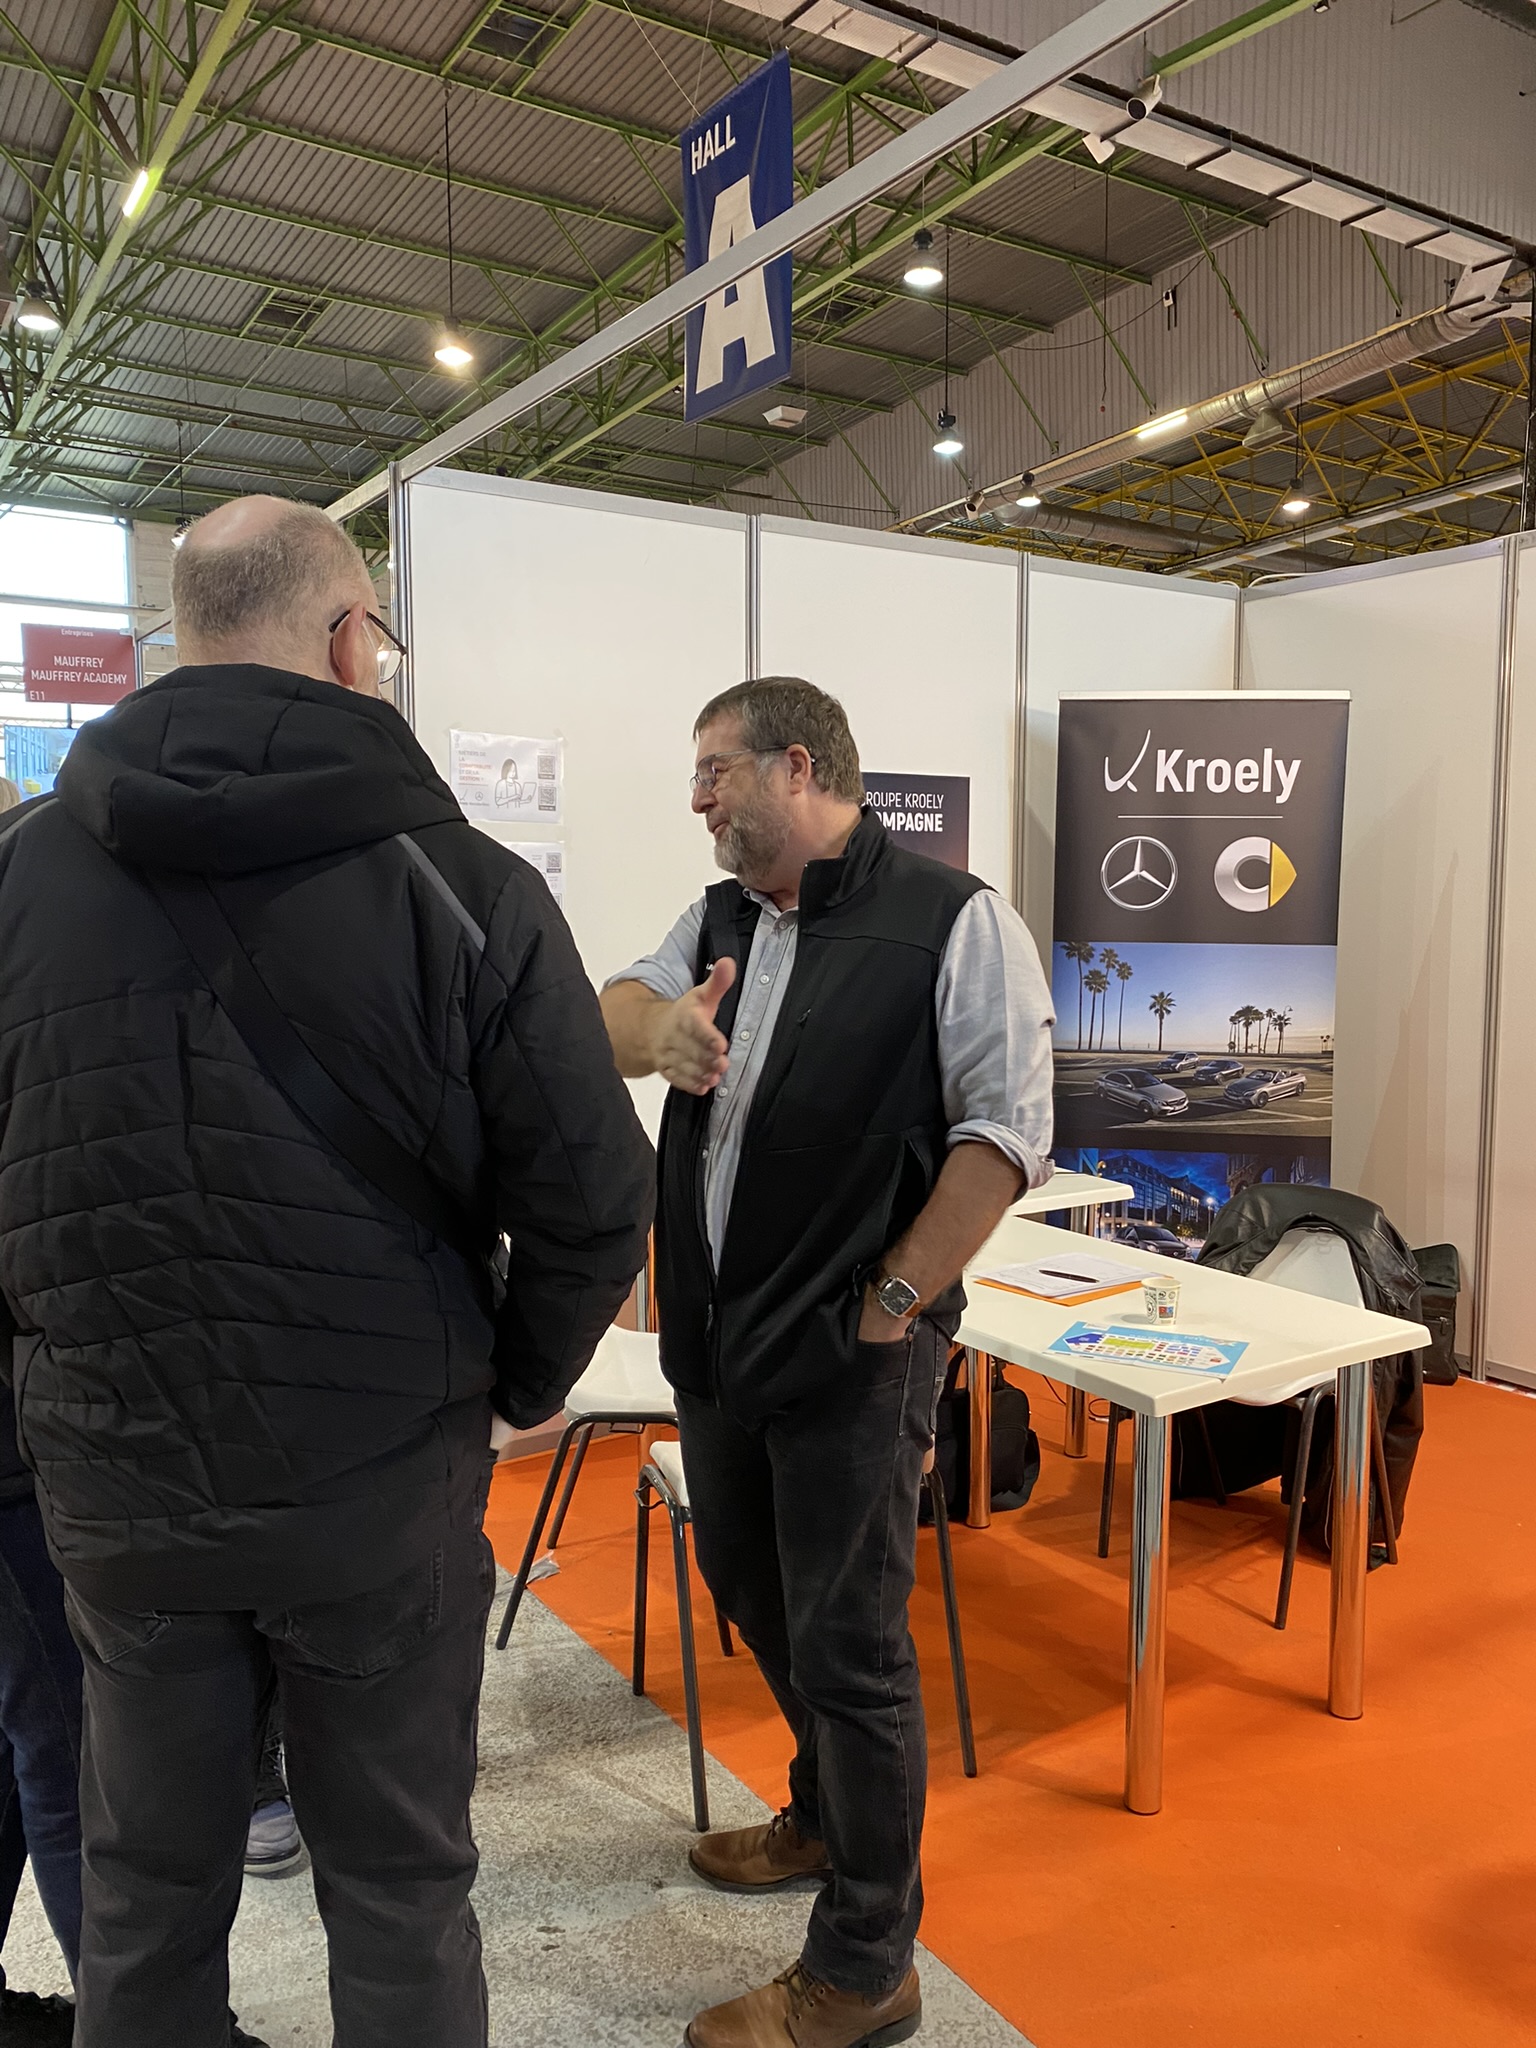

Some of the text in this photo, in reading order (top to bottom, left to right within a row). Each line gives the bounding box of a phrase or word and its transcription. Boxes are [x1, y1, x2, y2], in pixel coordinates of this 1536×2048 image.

[691, 114, 736, 175] HALL
[696, 174, 776, 394] A
[61, 628, 94, 637] Entreprises
[54, 655, 104, 668] MAUFFREY
[31, 669, 127, 684] MAUFFREY ACADEMY
[30, 690, 45, 701] E11
[1155, 747, 1301, 804] Kroely
[862, 791, 944, 809] ROUPE KROELY
